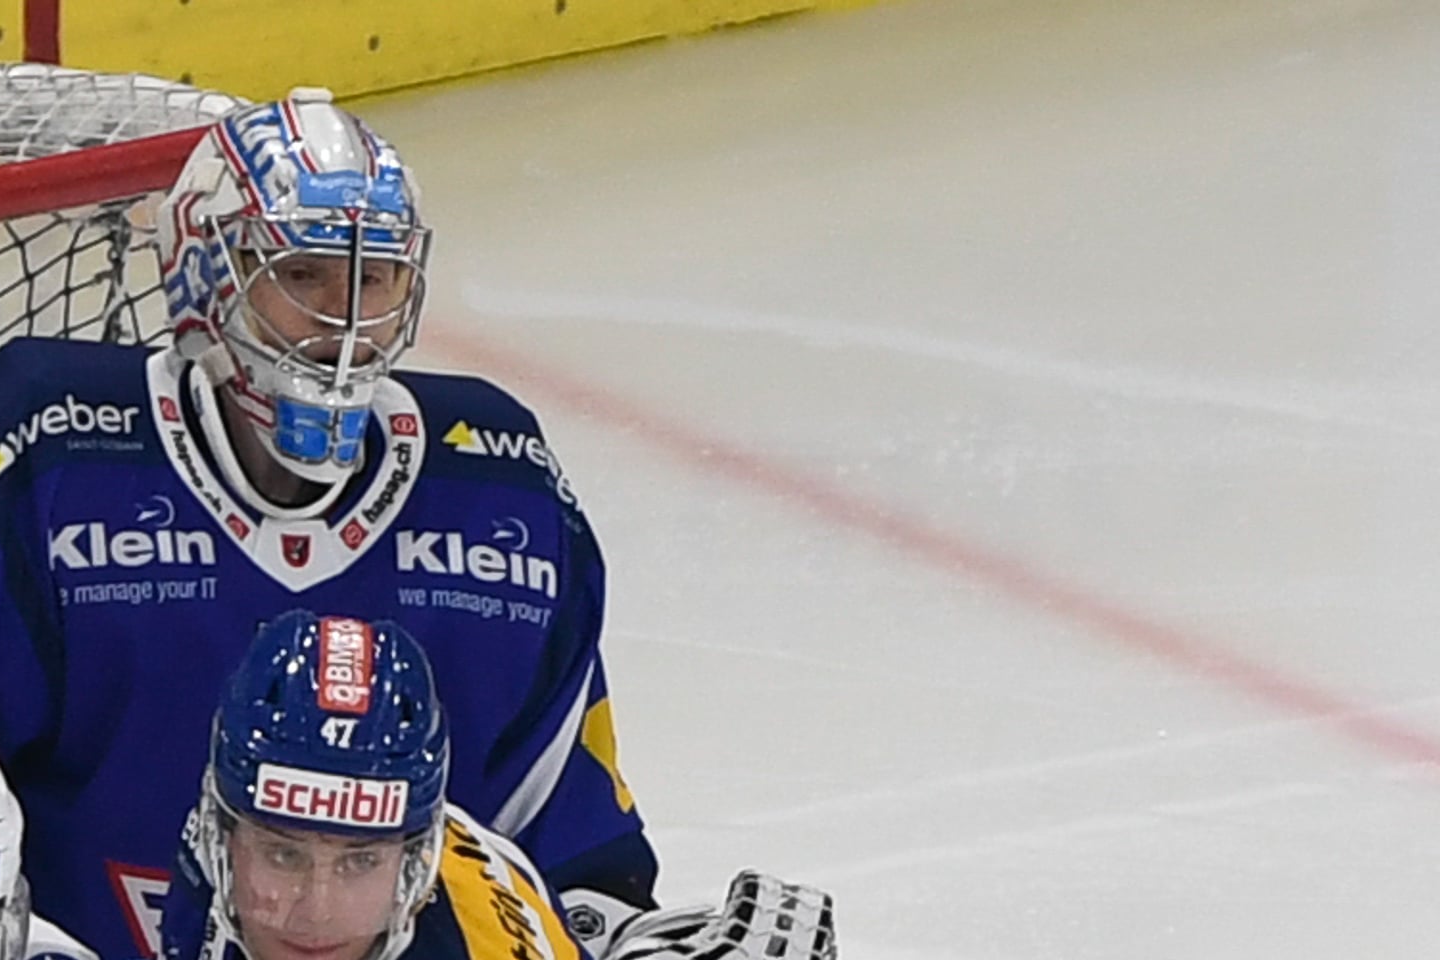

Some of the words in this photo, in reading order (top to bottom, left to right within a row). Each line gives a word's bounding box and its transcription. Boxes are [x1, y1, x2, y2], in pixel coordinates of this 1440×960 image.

[6, 393, 141, 455] weber
[361, 442, 413, 524] hapag.ch
[47, 521, 217, 571] Klein
[395, 530, 558, 599] Klein
[73, 580, 154, 605] manage
[157, 580, 198, 604] your
[201, 577, 218, 599] IT
[398, 588, 427, 607] we
[431, 589, 504, 618] manage
[319, 716, 359, 749] 47
